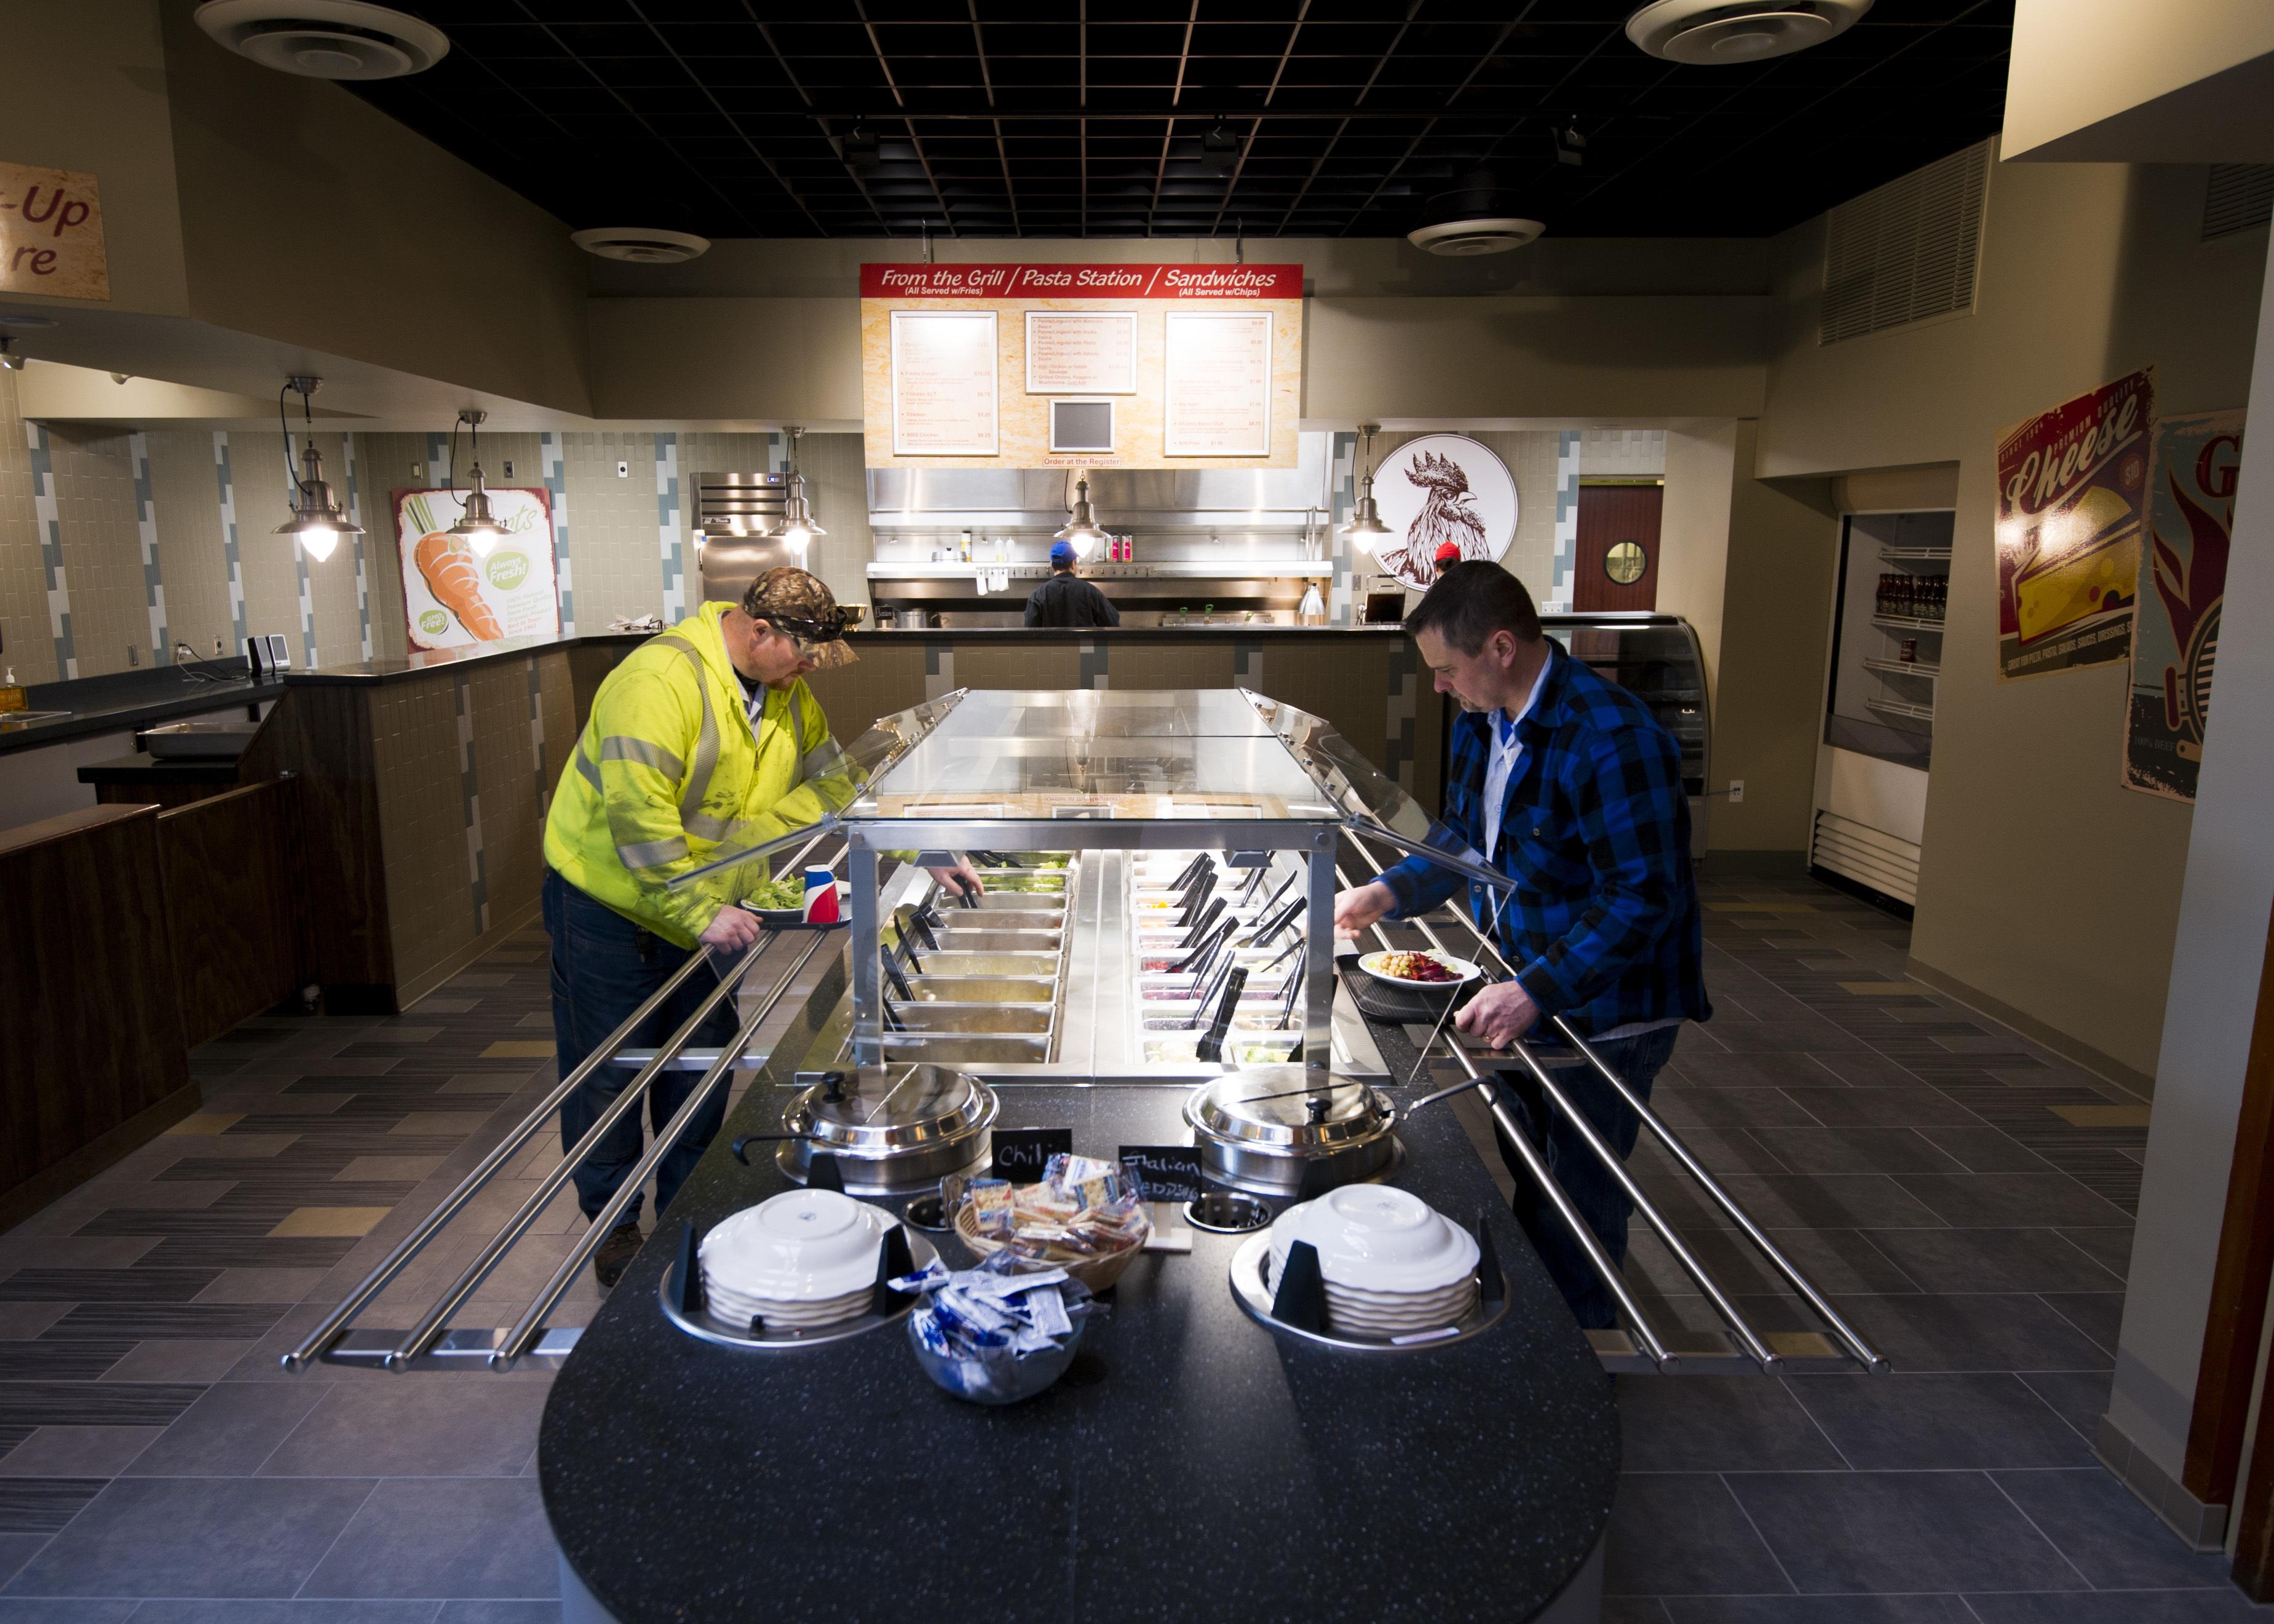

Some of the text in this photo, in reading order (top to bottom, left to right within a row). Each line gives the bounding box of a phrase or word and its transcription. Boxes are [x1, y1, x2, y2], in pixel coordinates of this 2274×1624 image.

[881, 269, 928, 286] From
[932, 269, 962, 286] the
[968, 269, 1006, 286] Grill
[1022, 269, 1072, 286] Pasta
[1077, 269, 1143, 287] Station
[1165, 269, 1277, 287] Sandwiches
[1179, 288, 1260, 297] (All Served w/Chips)
[2054, 379, 2134, 455] PREMIUM QUALITY
[2006, 394, 2139, 515] Cheese
[491, 557, 521, 570] Always
[490, 562, 526, 582] Fresh!
[421, 616, 445, 629] Free!
[427, 613, 442, 622] GMO
[2154, 739, 2175, 752] BEEF
